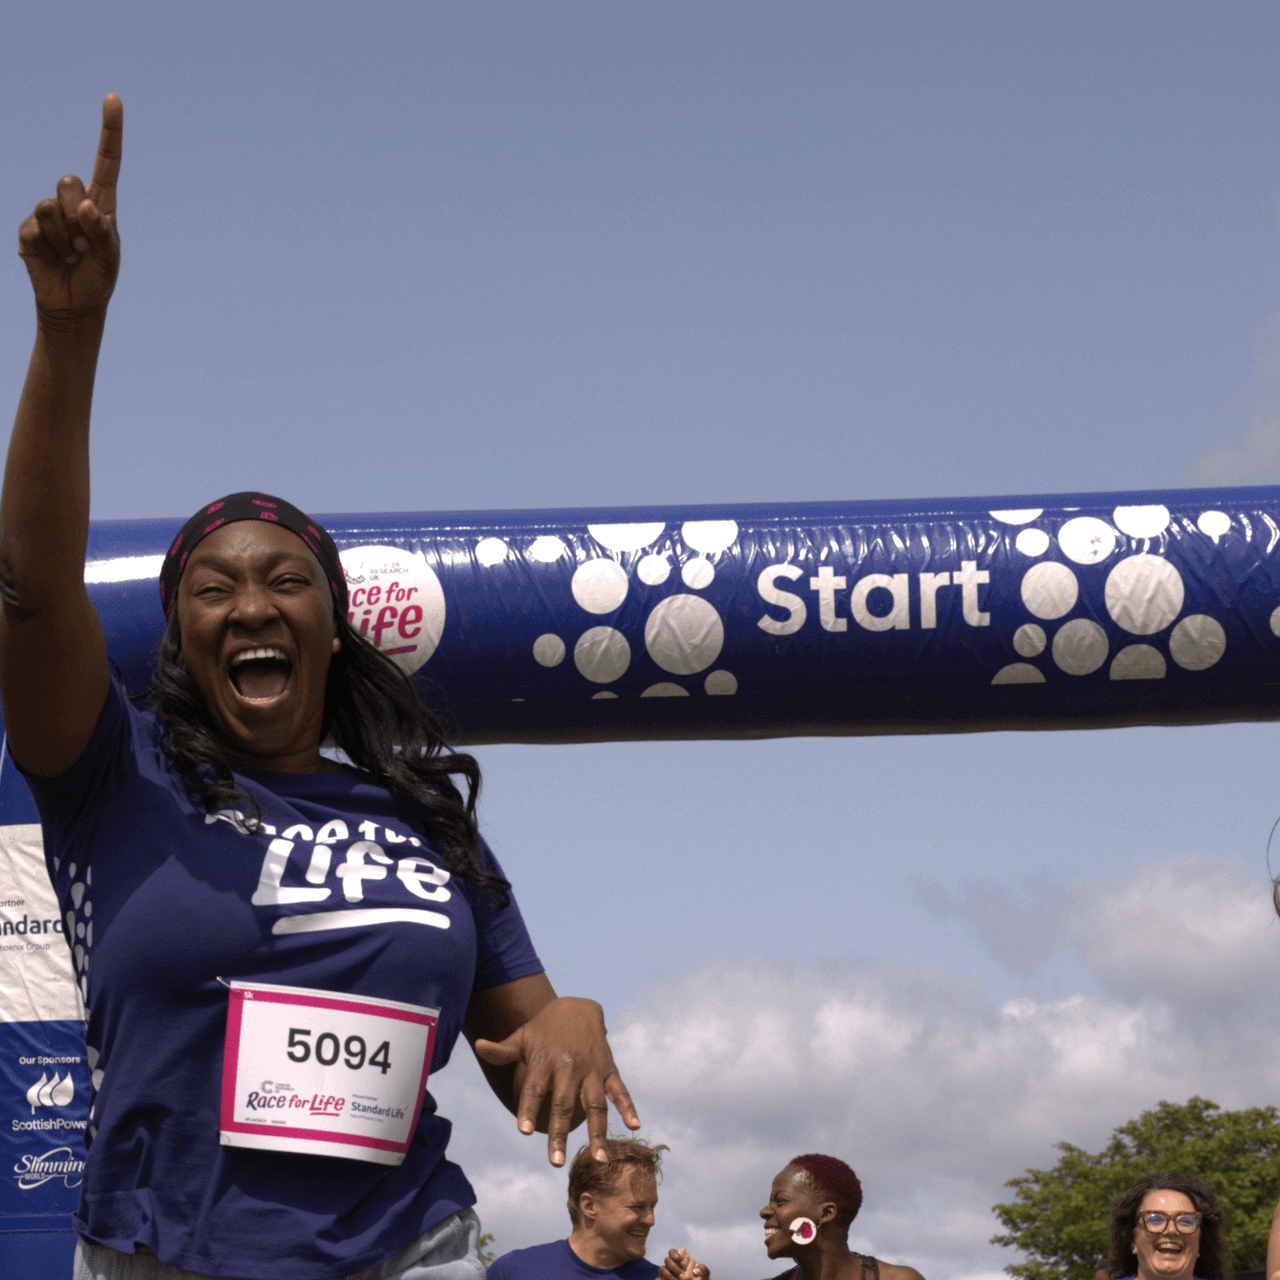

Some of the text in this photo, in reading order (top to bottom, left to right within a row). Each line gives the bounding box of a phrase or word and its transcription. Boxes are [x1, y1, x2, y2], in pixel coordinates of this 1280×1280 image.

[347, 582, 418, 608] ce for
[757, 559, 990, 636] Start
[347, 605, 423, 648] ife
[251, 838, 452, 906] Life
[25, 942, 51, 951] Group
[19, 1055, 81, 1066] Our Sponsors
[287, 1027, 392, 1075] 5094
[246, 1091, 346, 1112] Race for Life
[351, 1101, 405, 1119] Standard Life
